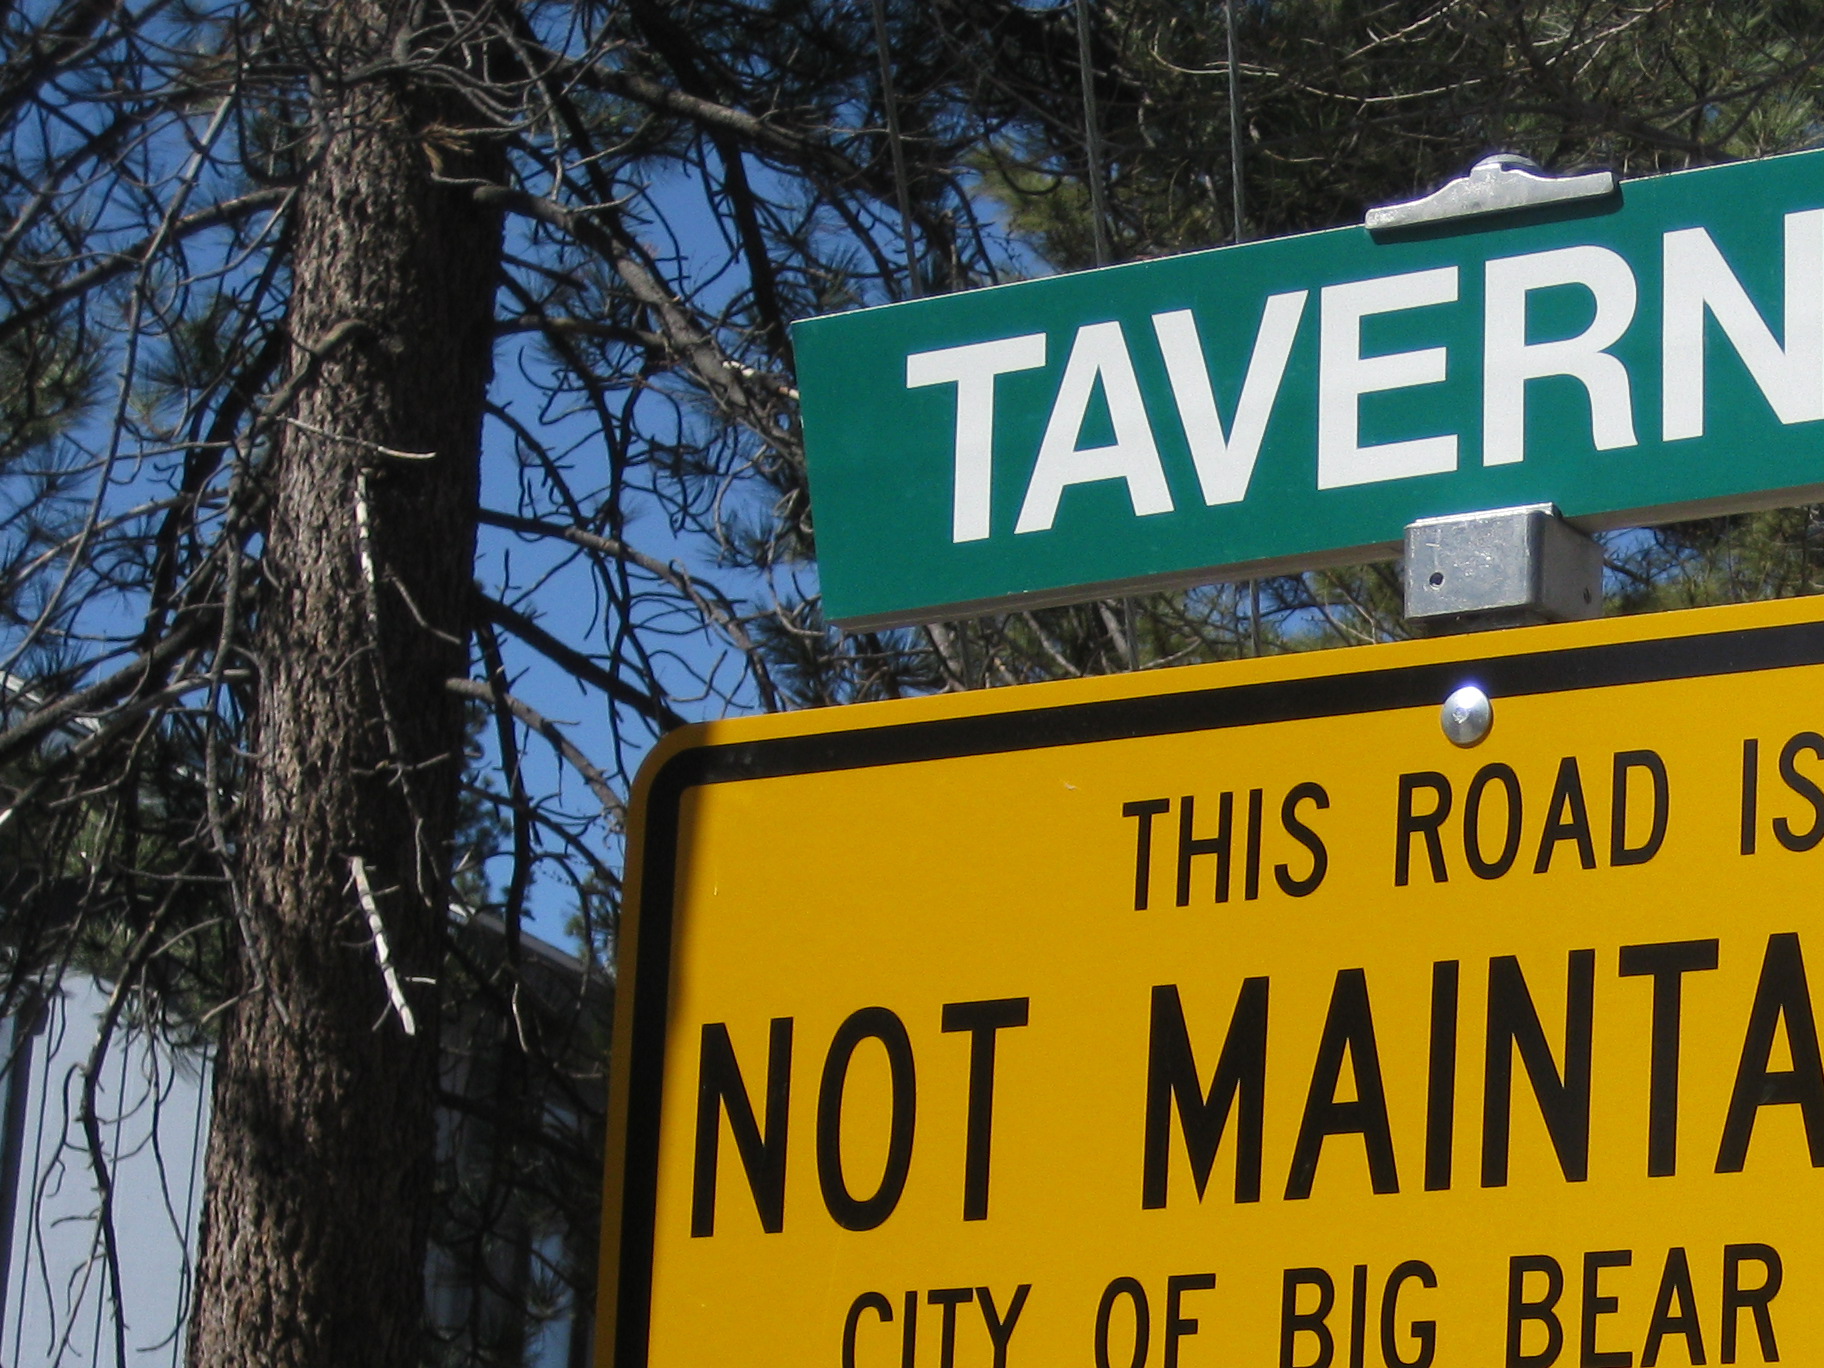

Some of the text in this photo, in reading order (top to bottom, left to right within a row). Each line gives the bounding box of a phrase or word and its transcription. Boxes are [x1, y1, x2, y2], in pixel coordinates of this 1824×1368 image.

[907, 209, 1824, 543] TAVERN
[1123, 782, 1329, 910] THIS
[1395, 750, 1669, 886] ROAD
[691, 997, 1029, 1238] NOT
